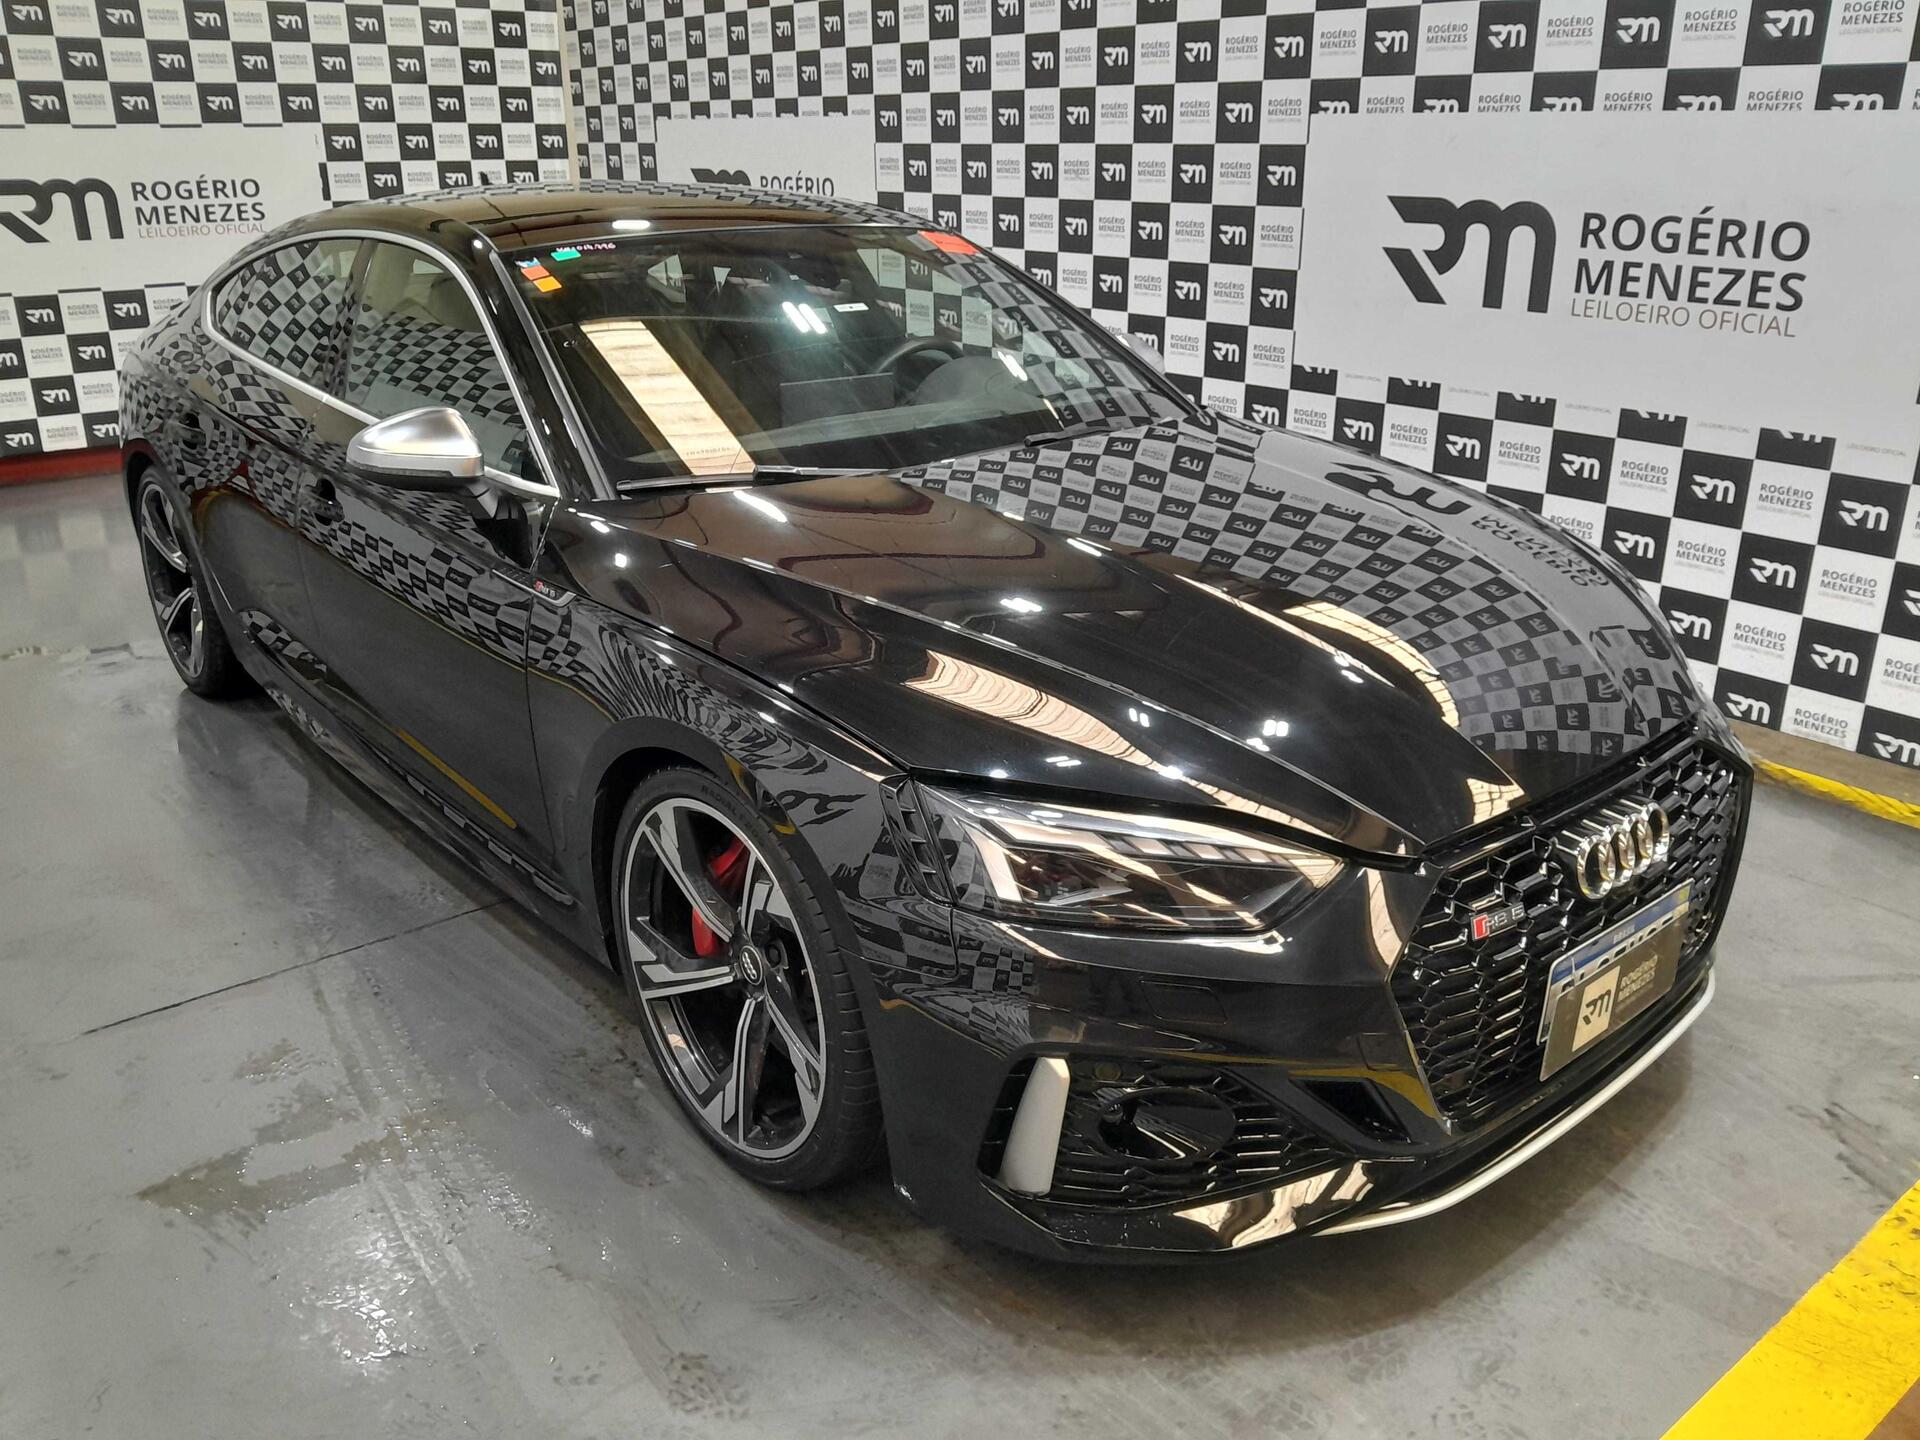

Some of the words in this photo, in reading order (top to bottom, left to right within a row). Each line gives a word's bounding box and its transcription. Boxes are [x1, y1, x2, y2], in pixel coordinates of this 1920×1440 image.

[1844, 0, 1905, 12] ROGÉRIO
[1548, 16, 1594, 28] ROGÉRIO
[1685, 8, 1738, 21] ROGÉRIO
[1841, 12, 1903, 24] MENEZES
[1427, 22, 1468, 34] ROGÉRIO
[1546, 28, 1592, 38] MENEZES
[1684, 21, 1736, 32] MENEZES
[1426, 34, 1467, 44] MENEZES
[1366, 96, 1404, 105] ROGÉRIO
[1478, 94, 1521, 104] ROGÉRIO
[1604, 92, 1653, 102] ROGÉRIO
[1748, 89, 1804, 101] ROGÉRIO
[131, 175, 260, 201] ROGÉRIO
[134, 203, 266, 225] MENEZES
[138, 225, 211, 239] LEILOEIRO
[215, 223, 266, 235] OFICIAL
[1579, 206, 1810, 262] ROGÉRIO
[1573, 258, 1806, 312] MENEZES
[1570, 298, 1690, 327] LEILOEIRO
[1698, 309, 1797, 338] OFICIAL
[1391, 423, 1428, 436] ROGÉRIO
[1390, 432, 1427, 446] MENEZES
[1500, 441, 1541, 454] ROGÉRIO
[1498, 450, 1540, 464] MENEZES
[1622, 460, 1668, 475] ROGÉRIO
[1620, 470, 1667, 486] MENEZES
[1760, 483, 1813, 500] ROGÉRIO
[1759, 494, 1812, 511] MENEZES
[1678, 540, 1726, 557] ROGÉRIO
[1676, 550, 1725, 568] MENEZES
[1822, 569, 1877, 588] ROGÉRIO
[1820, 579, 1876, 599] MENEZES
[1736, 623, 1786, 641] ROGÉRIO
[1734, 632, 1784, 652] MENEZES
[1886, 657, 1920, 675] ROGÉ
[1883, 668, 1920, 686] MENE
[1795, 708, 1848, 729] ROGÉRIO
[1793, 718, 1846, 740] MENEZES
